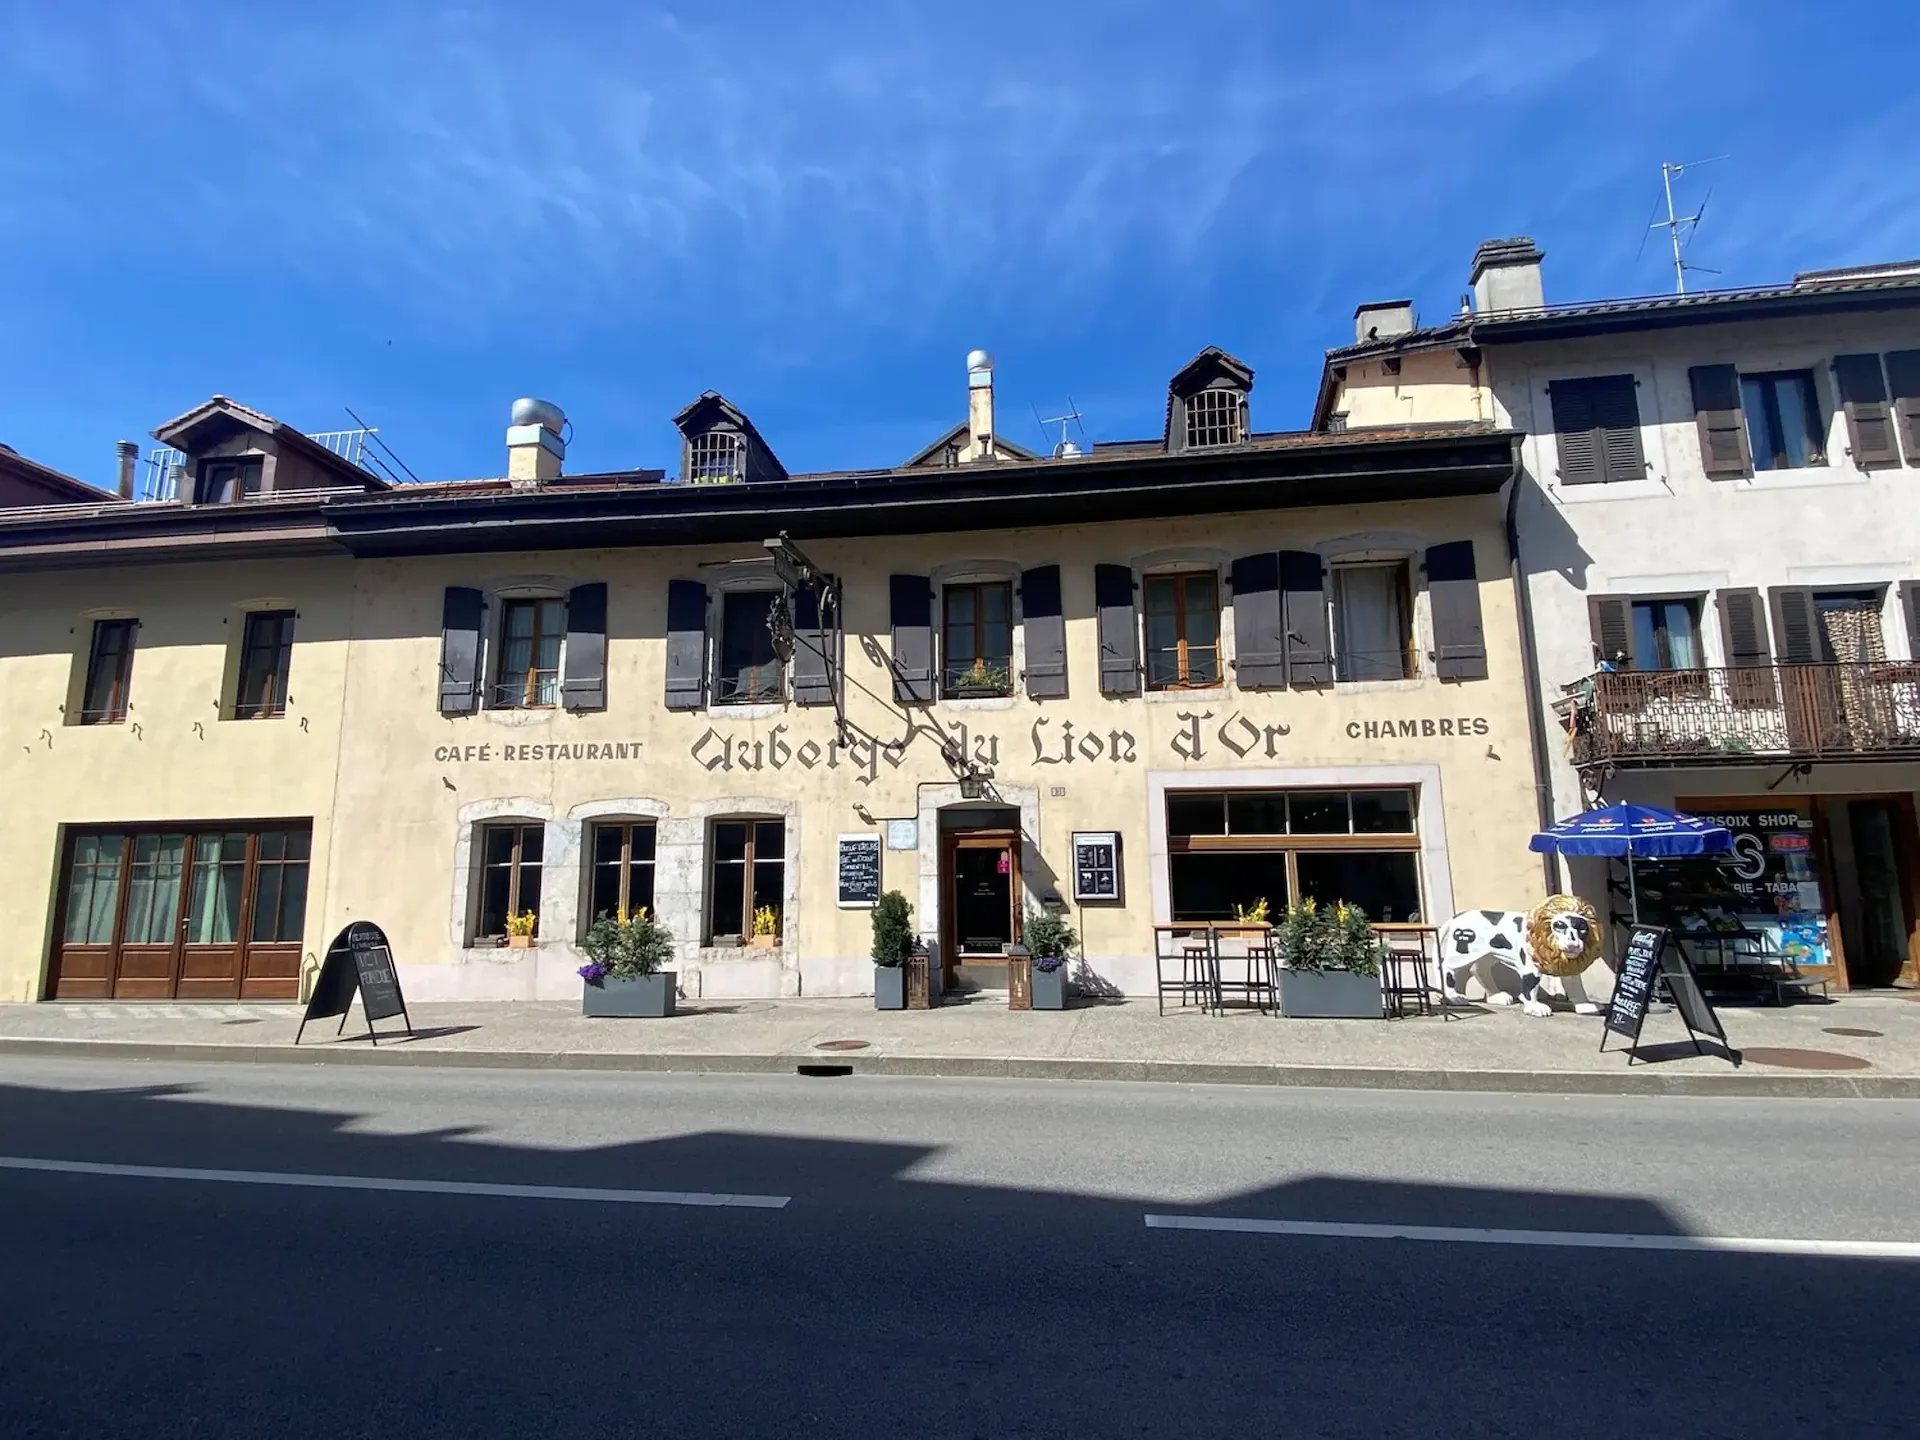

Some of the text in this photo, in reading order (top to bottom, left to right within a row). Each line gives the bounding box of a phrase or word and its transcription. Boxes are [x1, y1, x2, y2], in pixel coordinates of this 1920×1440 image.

[1346, 718, 1489, 739] CHAMBRES
[434, 742, 643, 763] CAFÉ RESTAURANT
[690, 709, 1291, 786] Auberge du Lion d'Or
[1758, 814, 1798, 827] SHOP
